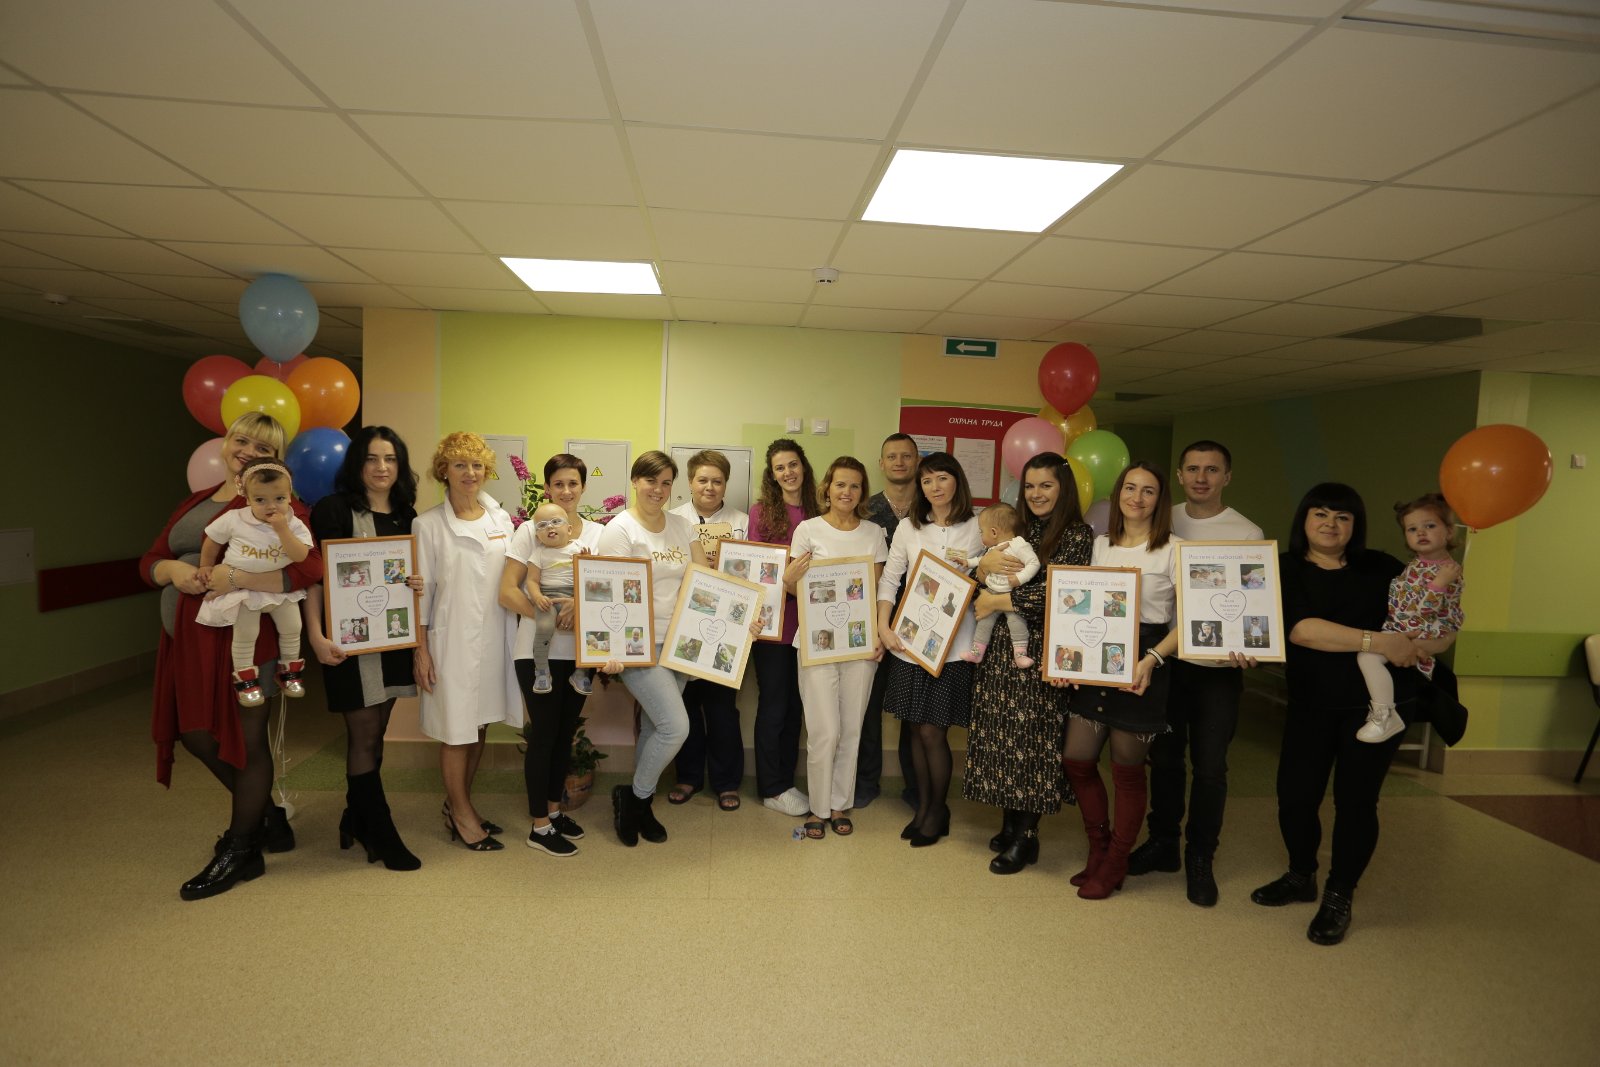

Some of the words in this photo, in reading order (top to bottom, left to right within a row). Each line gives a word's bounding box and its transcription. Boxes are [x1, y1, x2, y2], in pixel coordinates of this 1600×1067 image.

[949, 417, 978, 426] ОХРАНА
[981, 419, 1003, 427] ТРУДА
[241, 545, 281, 560] РАНО
[652, 549, 685, 562] РАНО
